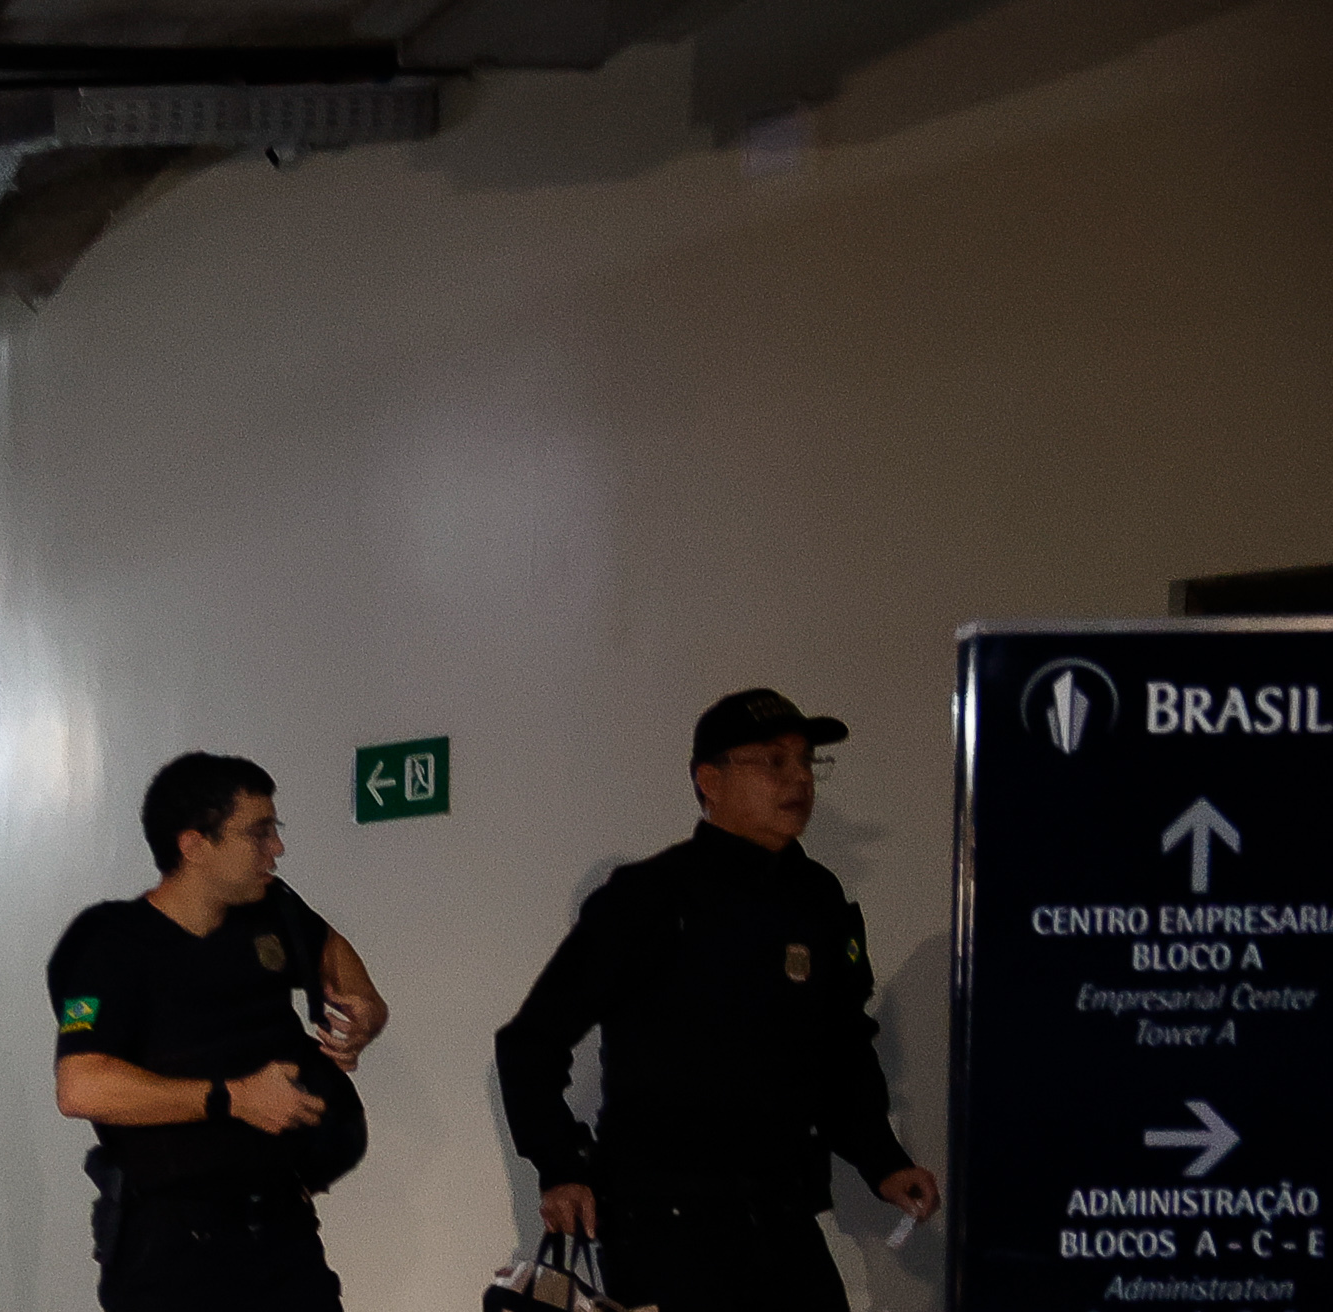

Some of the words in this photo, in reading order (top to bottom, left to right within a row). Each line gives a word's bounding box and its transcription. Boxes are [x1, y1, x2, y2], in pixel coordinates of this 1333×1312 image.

[1147, 681, 1333, 734] BRASIL
[1031, 906, 1150, 936] CENTRO
[1159, 904, 1333, 935] EMPRESARI
[1132, 942, 1232, 972] BLOCO
[1240, 941, 1265, 971] A
[1075, 982, 1227, 1016] Empresarial
[1231, 981, 1317, 1011] Center
[1136, 1018, 1211, 1047] Tower
[1215, 1018, 1237, 1046] A
[1067, 1181, 1320, 1223] ADMINISTRAÇÃO
[1060, 1229, 1177, 1258] BLOCOS
[1195, 1229, 1218, 1257] A
[1251, 1228, 1274, 1258] C
[1307, 1228, 1325, 1258] E
[1104, 1274, 1295, 1302] Administration
